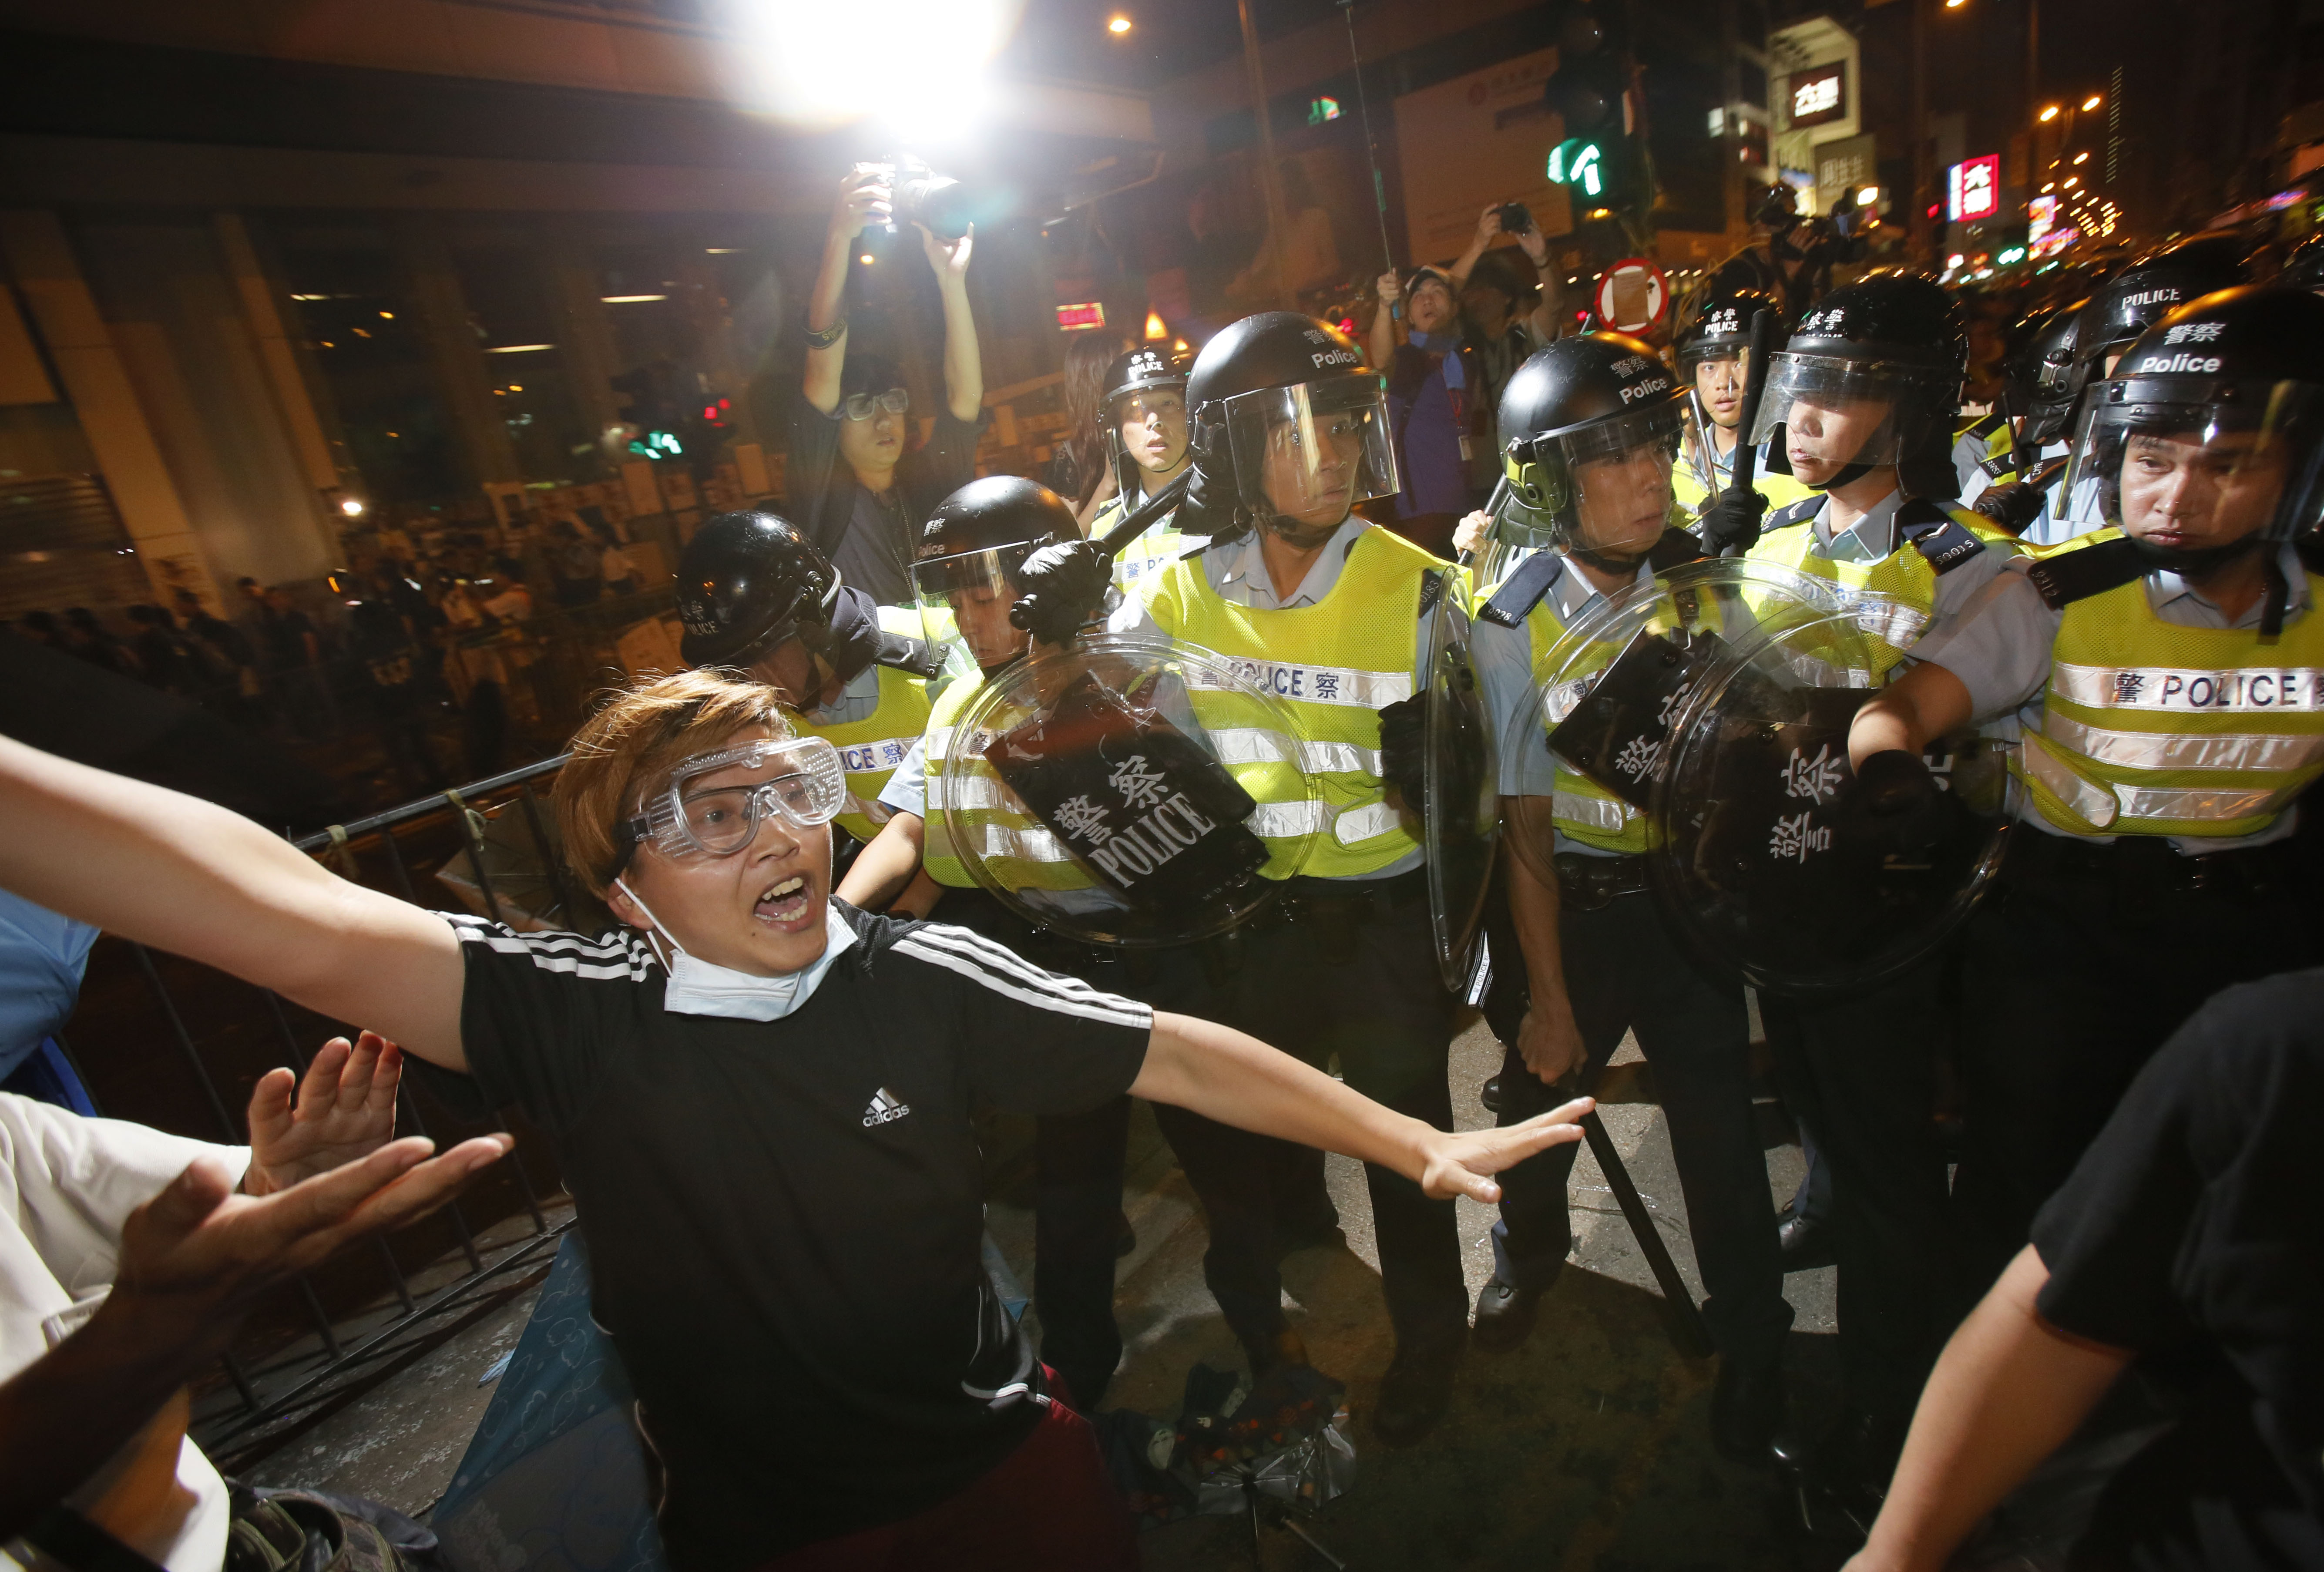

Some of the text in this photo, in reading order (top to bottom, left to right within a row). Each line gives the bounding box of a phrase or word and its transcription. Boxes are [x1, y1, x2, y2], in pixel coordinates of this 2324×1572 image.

[2121, 289, 2180, 310] POLICE
[1705, 321, 1738, 335] POLICE
[2164, 322, 2226, 345] 警察
[1128, 361, 1164, 378] POLICE
[1311, 349, 1357, 369] Police
[1609, 356, 1649, 379] 警察
[2139, 353, 2221, 373] Police
[1619, 378, 1667, 405] Police
[924, 518, 946, 537] 警察
[1419, 580, 1439, 607] 0183
[1316, 672, 1339, 699] 察
[2114, 672, 2145, 703] 警
[2161, 675, 2297, 707] POLICE
[883, 743, 904, 765] 察
[1053, 755, 1169, 845] 警察
[1769, 743, 1843, 864] 警察
[1088, 792, 1216, 889] POLICE
[863, 1105, 909, 1127] adidas
